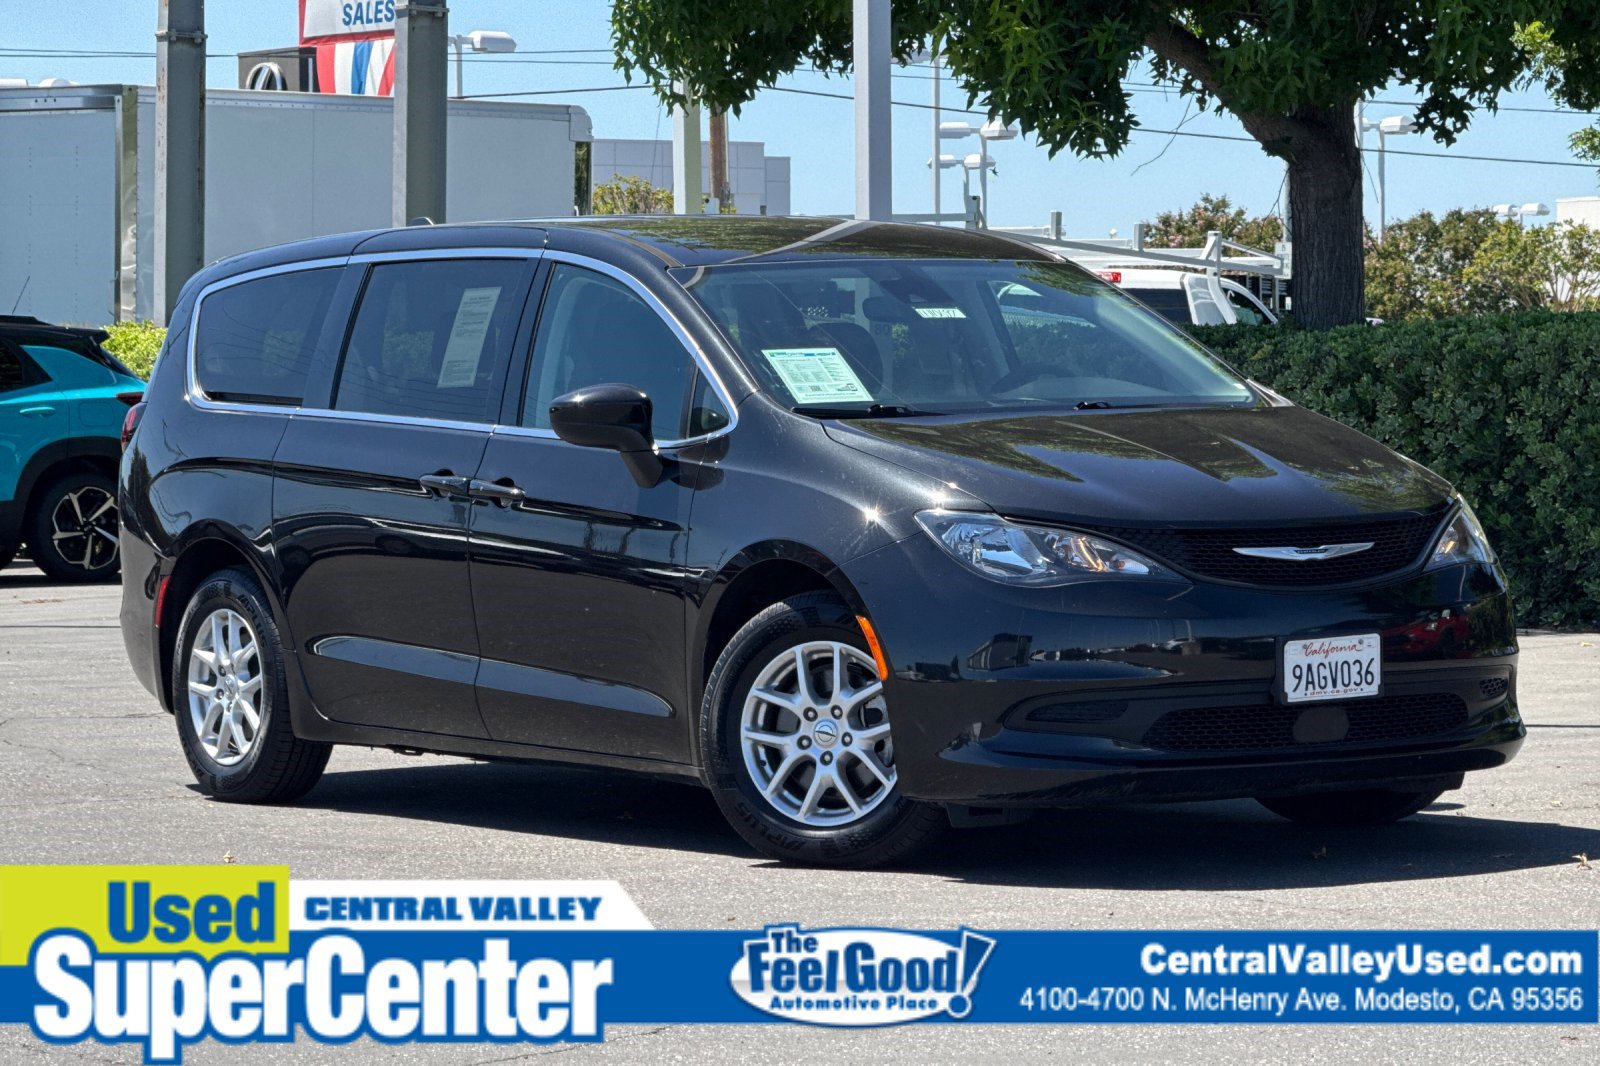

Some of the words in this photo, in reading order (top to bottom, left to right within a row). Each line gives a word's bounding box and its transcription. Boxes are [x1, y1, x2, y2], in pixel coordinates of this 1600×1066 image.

[342, 0, 396, 26] SALES
[1303, 641, 1361, 659] California
[1292, 657, 1375, 693] 9AGV036
[1309, 687, 1359, 696] dmv.ca.gov
